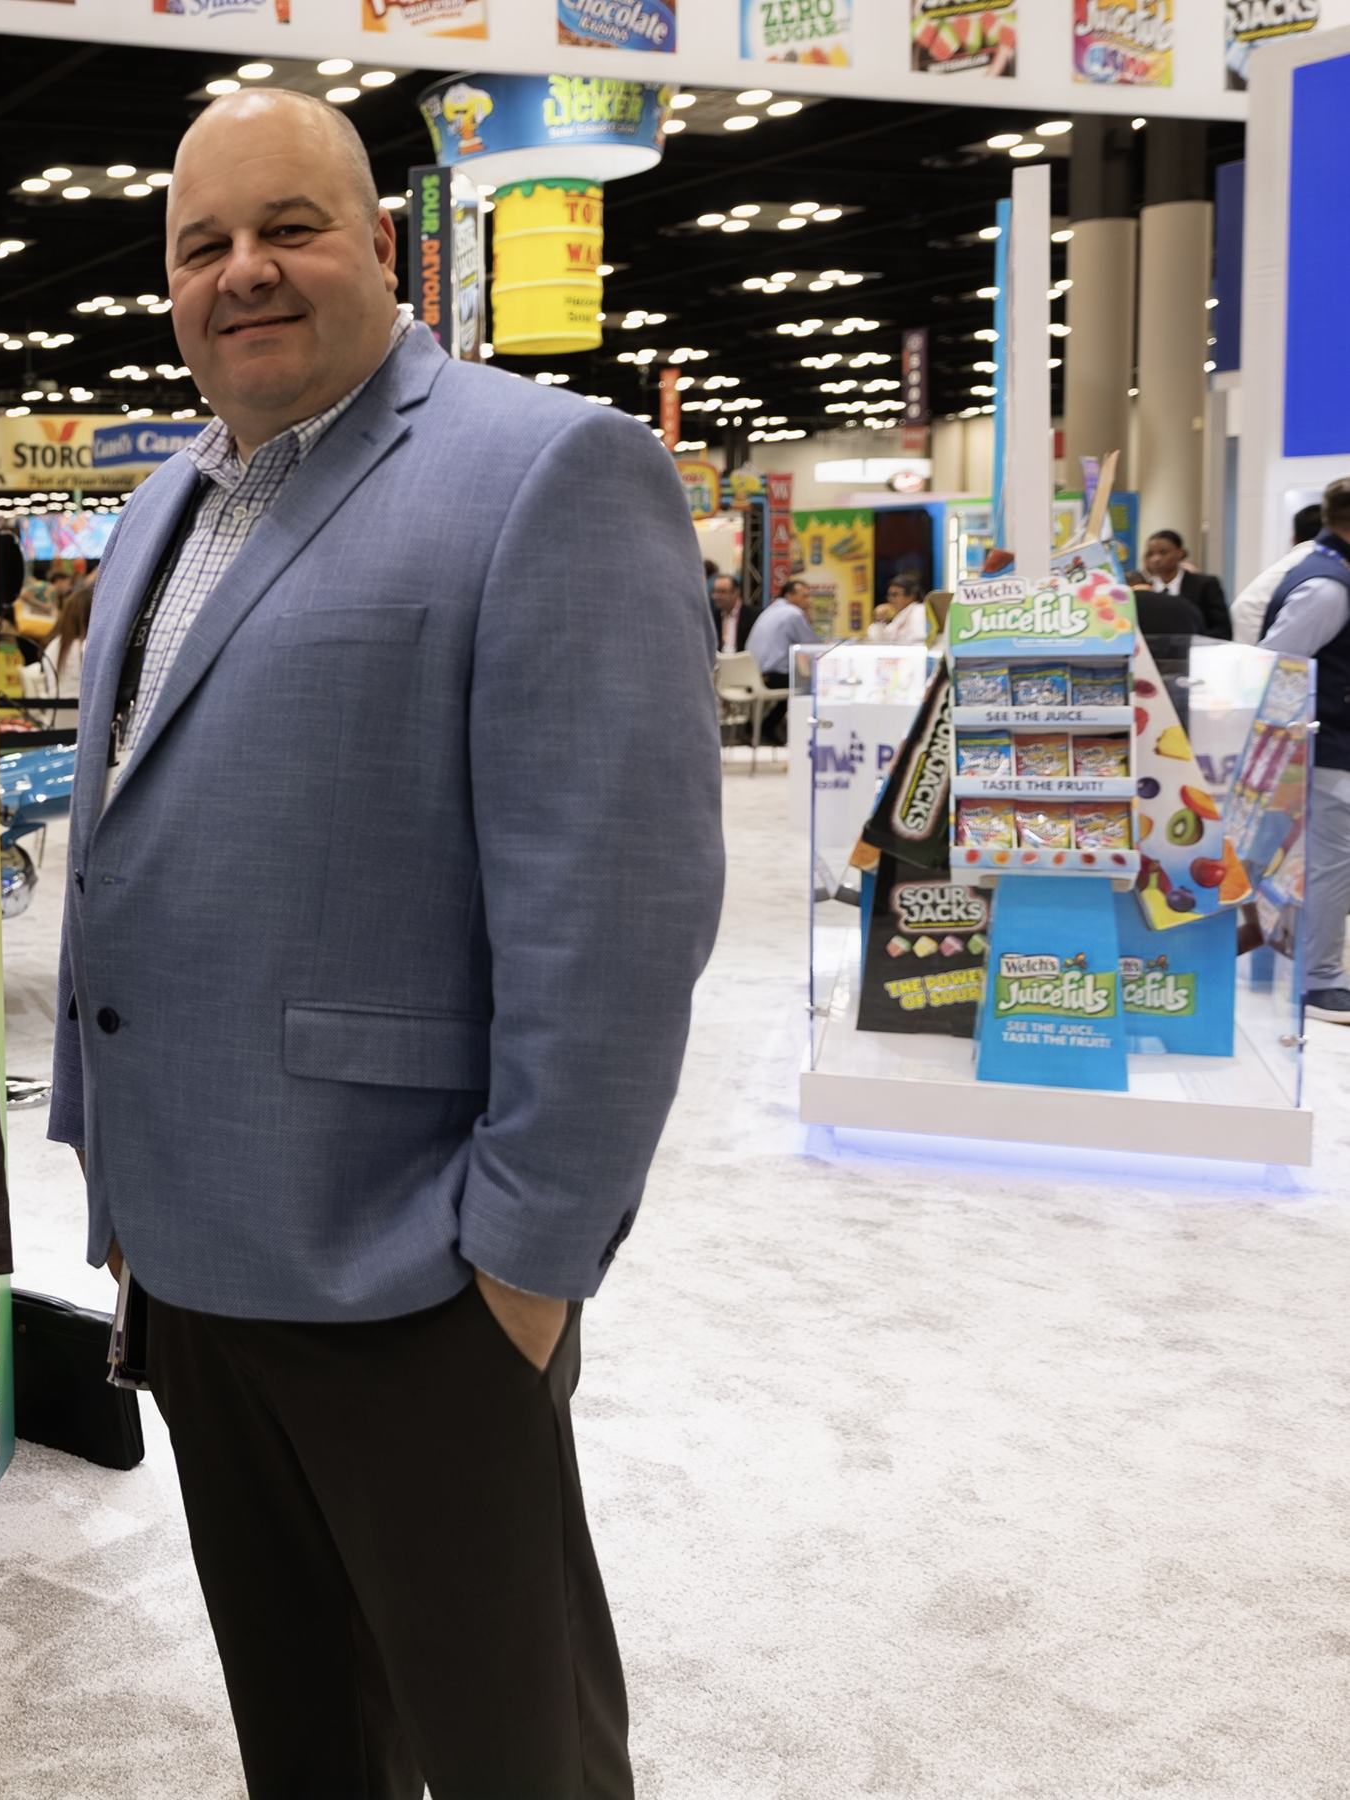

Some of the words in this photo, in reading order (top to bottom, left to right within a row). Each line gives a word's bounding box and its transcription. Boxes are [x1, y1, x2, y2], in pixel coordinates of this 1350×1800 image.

[761, 0, 836, 28] ZERO
[13, 442, 93, 469] STORC
[963, 583, 1023, 600] Welch's
[958, 592, 1090, 640] Juicefuls
[985, 711, 1009, 722] SEE
[1014, 711, 1040, 722] THE
[981, 780, 1021, 791] TASTE
[1026, 780, 1052, 791] THE
[1057, 781, 1104, 792] FRUIT!
[900, 885, 967, 906] SOUR
[906, 901, 984, 923] JACKS
[1004, 959, 1056, 973] Welch's
[886, 978, 923, 997] THE
[998, 970, 1109, 1014] Juicefuls
[1123, 971, 1190, 1012] cefuls
[901, 992, 927, 1010] OF
[1005, 1020, 1029, 1031] SEE
[1031, 1022, 1056, 1034] THE
[1002, 1031, 1040, 1044] TASTE
[1044, 1034, 1067, 1045] THE
